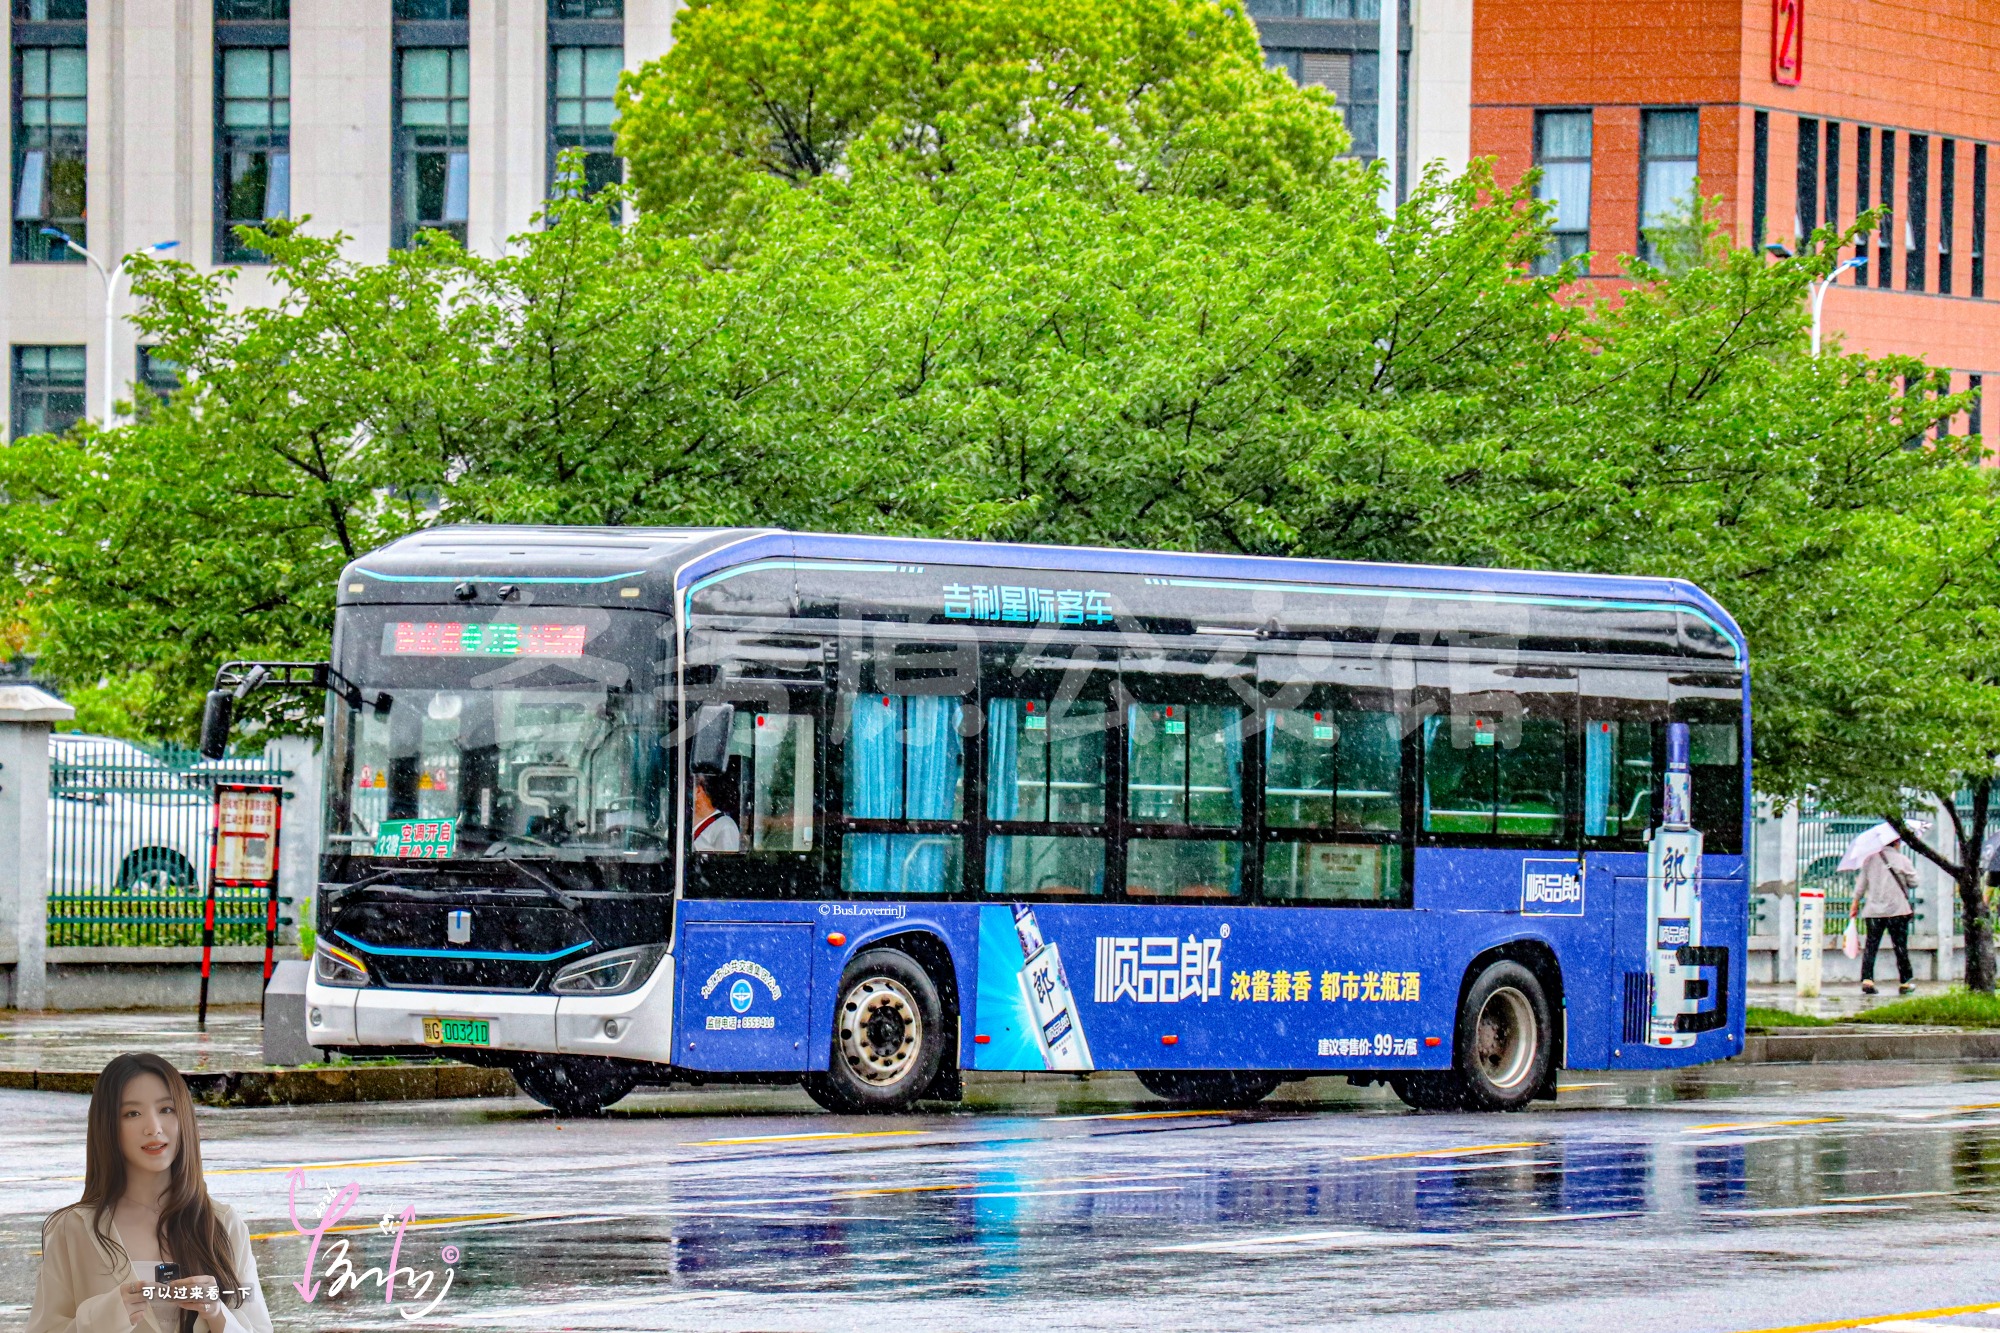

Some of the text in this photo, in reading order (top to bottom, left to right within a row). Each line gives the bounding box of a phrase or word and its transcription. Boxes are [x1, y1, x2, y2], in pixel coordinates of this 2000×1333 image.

[943, 583, 1113, 625] 吉利星际客车
[401, 823, 452, 842] 空调开启
[1527, 873, 1581, 903] 顺品郎
[1658, 925, 1690, 945] 顺品郎
[1802, 903, 1813, 960] 严禁开挖
[1230, 970, 1421, 1002] 浓酱兼香 都市光瓶酒
